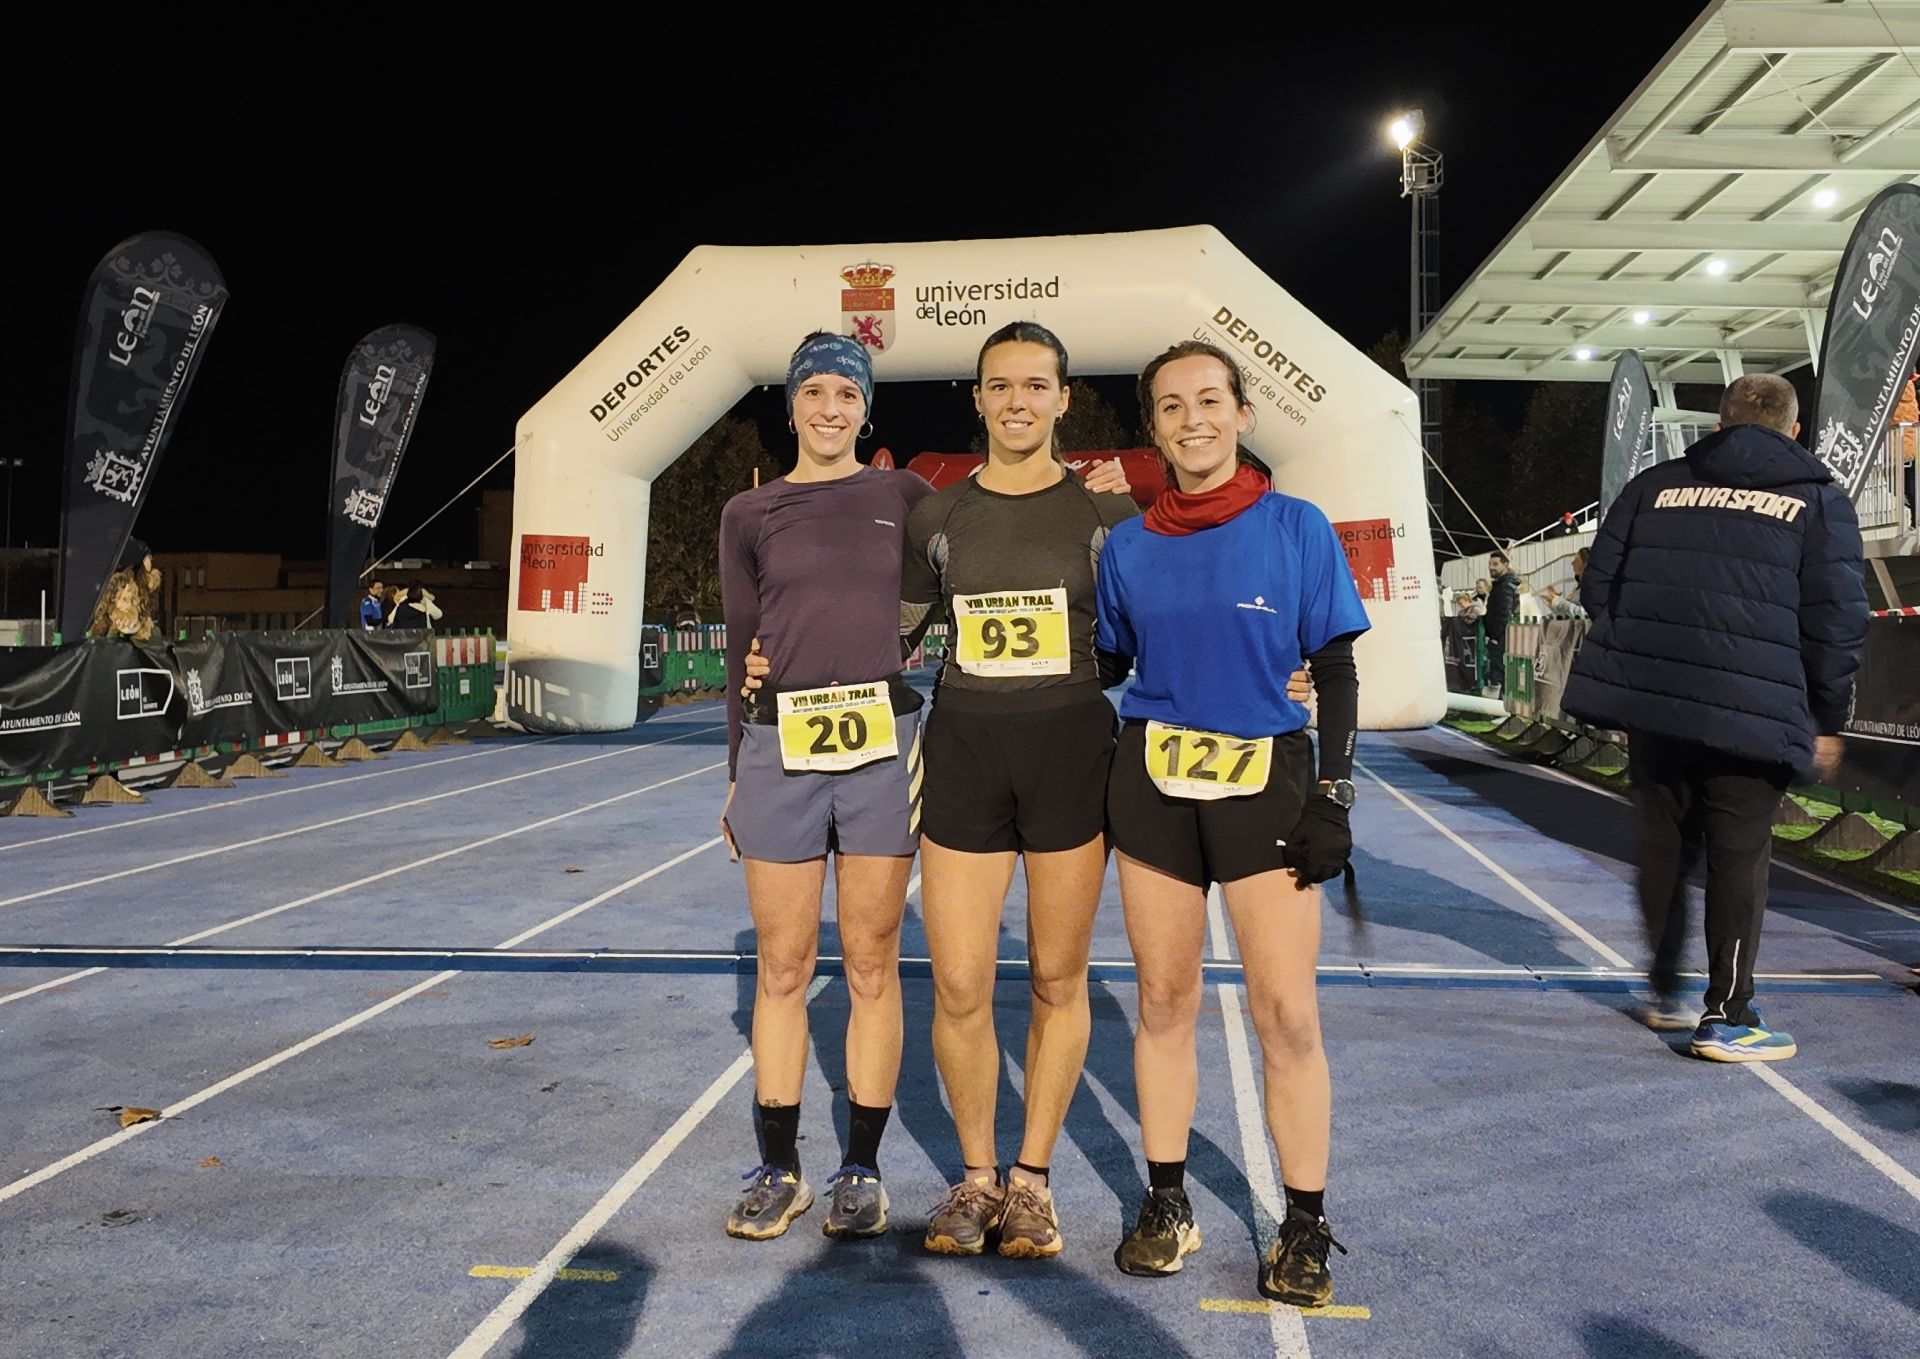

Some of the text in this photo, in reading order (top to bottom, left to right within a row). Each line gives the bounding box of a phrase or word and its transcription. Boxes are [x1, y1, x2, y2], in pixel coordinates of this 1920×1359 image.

[915, 275, 1060, 303] universidad
[915, 301, 986, 327] de león
[589, 325, 691, 423] DEPORTES
[1212, 305, 1327, 403] DEPORTES
[140, 360, 186, 461] AYUNTAMIENTO
[181, 340, 195, 359] DE
[190, 304, 209, 340] LEÓN
[1862, 323, 1915, 445] AYUNTAMIENTO
[606, 383, 670, 442] Universidad
[668, 371, 685, 386] de
[1259, 383, 1276, 401] de
[1276, 396, 1308, 426] León
[1654, 486, 1807, 523] RUNVASPORT
[985, 596, 1019, 609] URBAN
[1021, 594, 1054, 606] TRAIL
[981, 617, 1040, 659] 93
[120, 684, 140, 701] LEÓN
[809, 691, 846, 706] URBAN
[847, 687, 877, 701] TRAIL
[1, 715, 54, 730] AYUNTAMIENTO
[62, 710, 81, 723] LEÓN
[805, 711, 868, 755] 20
[1896, 724, 1906, 737] DE
[1907, 723, 1920, 739] LEÓ
[1159, 734, 1258, 784] 127
